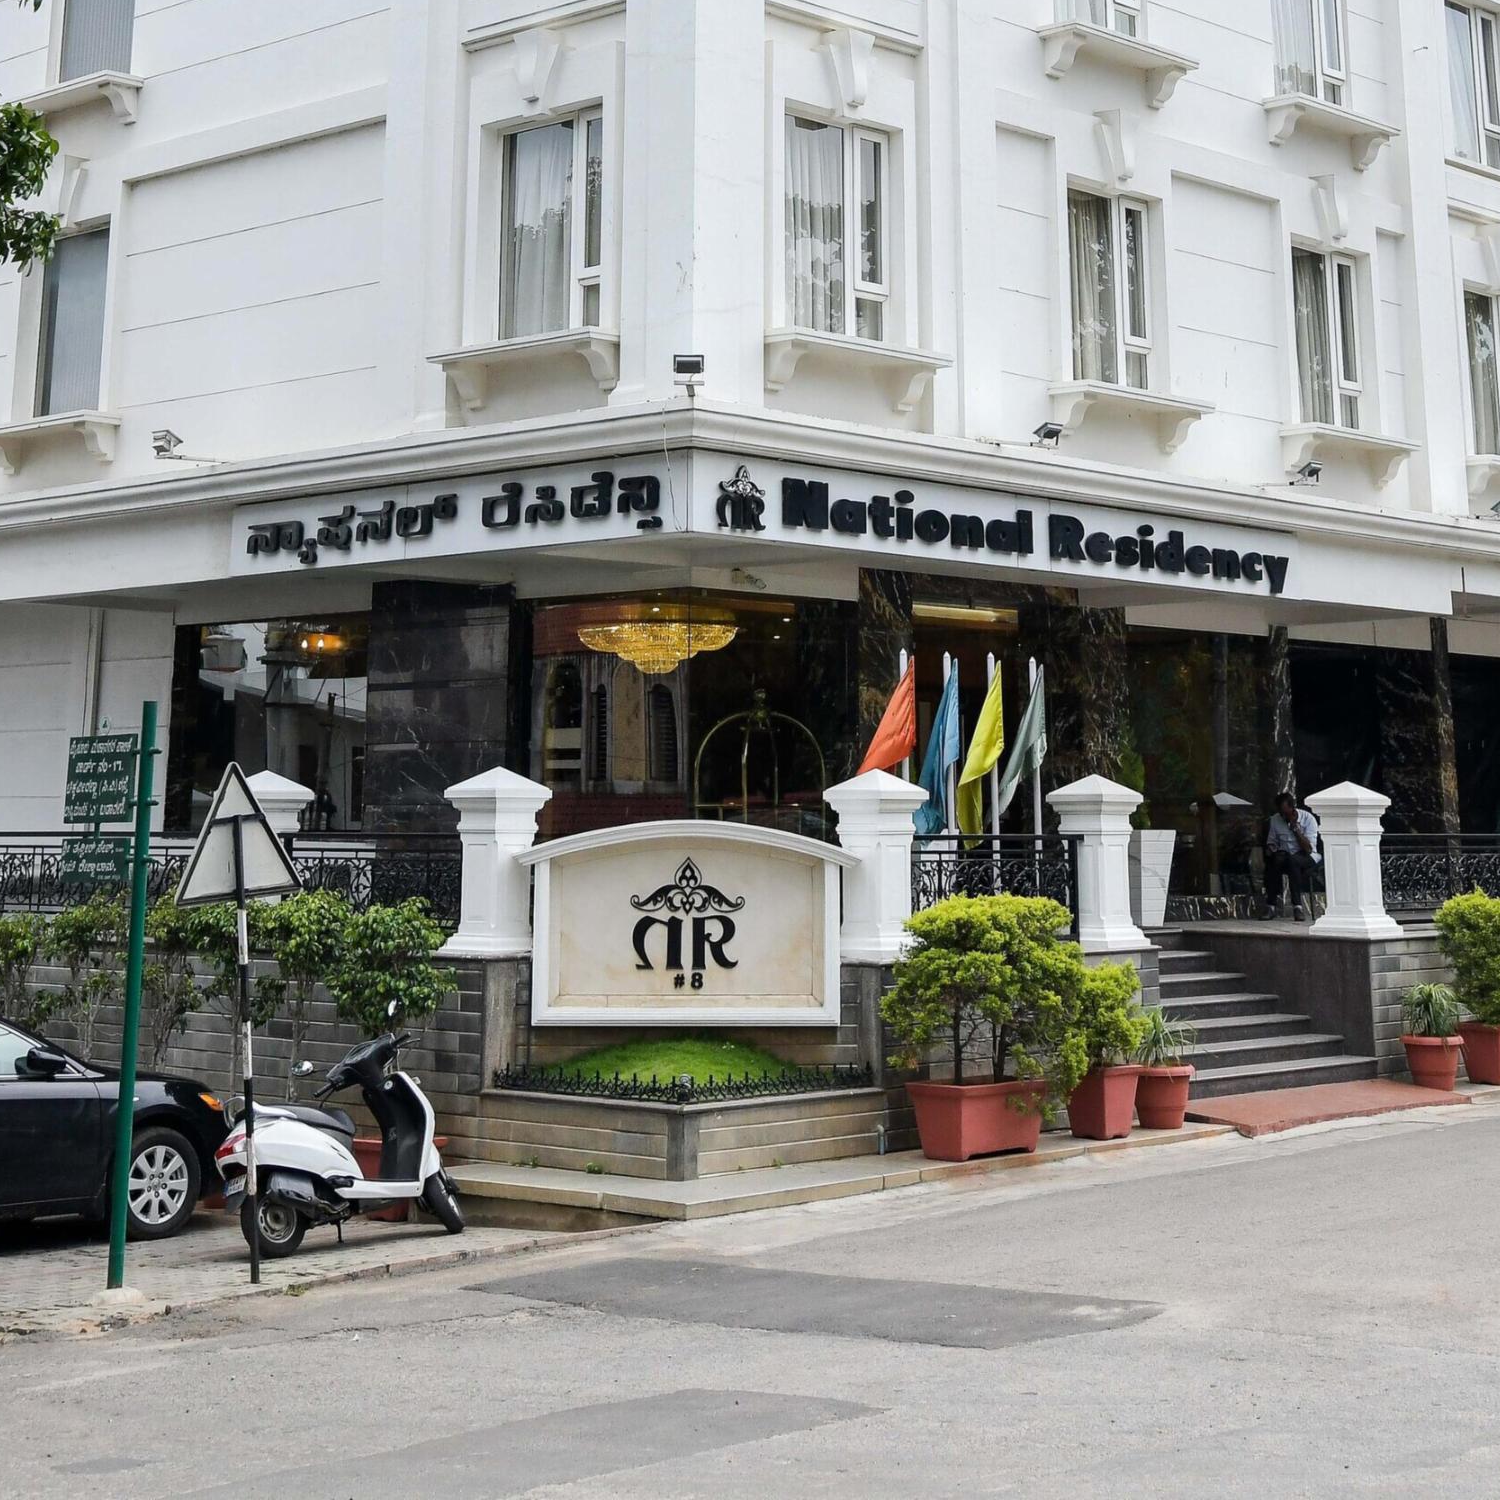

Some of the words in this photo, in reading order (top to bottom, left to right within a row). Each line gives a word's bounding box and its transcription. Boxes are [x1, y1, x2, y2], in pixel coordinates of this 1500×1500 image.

[246, 493, 458, 564] ನ್ಯಾಷನಲ್
[782, 477, 1034, 554] National
[1048, 514, 1290, 594] Residency
